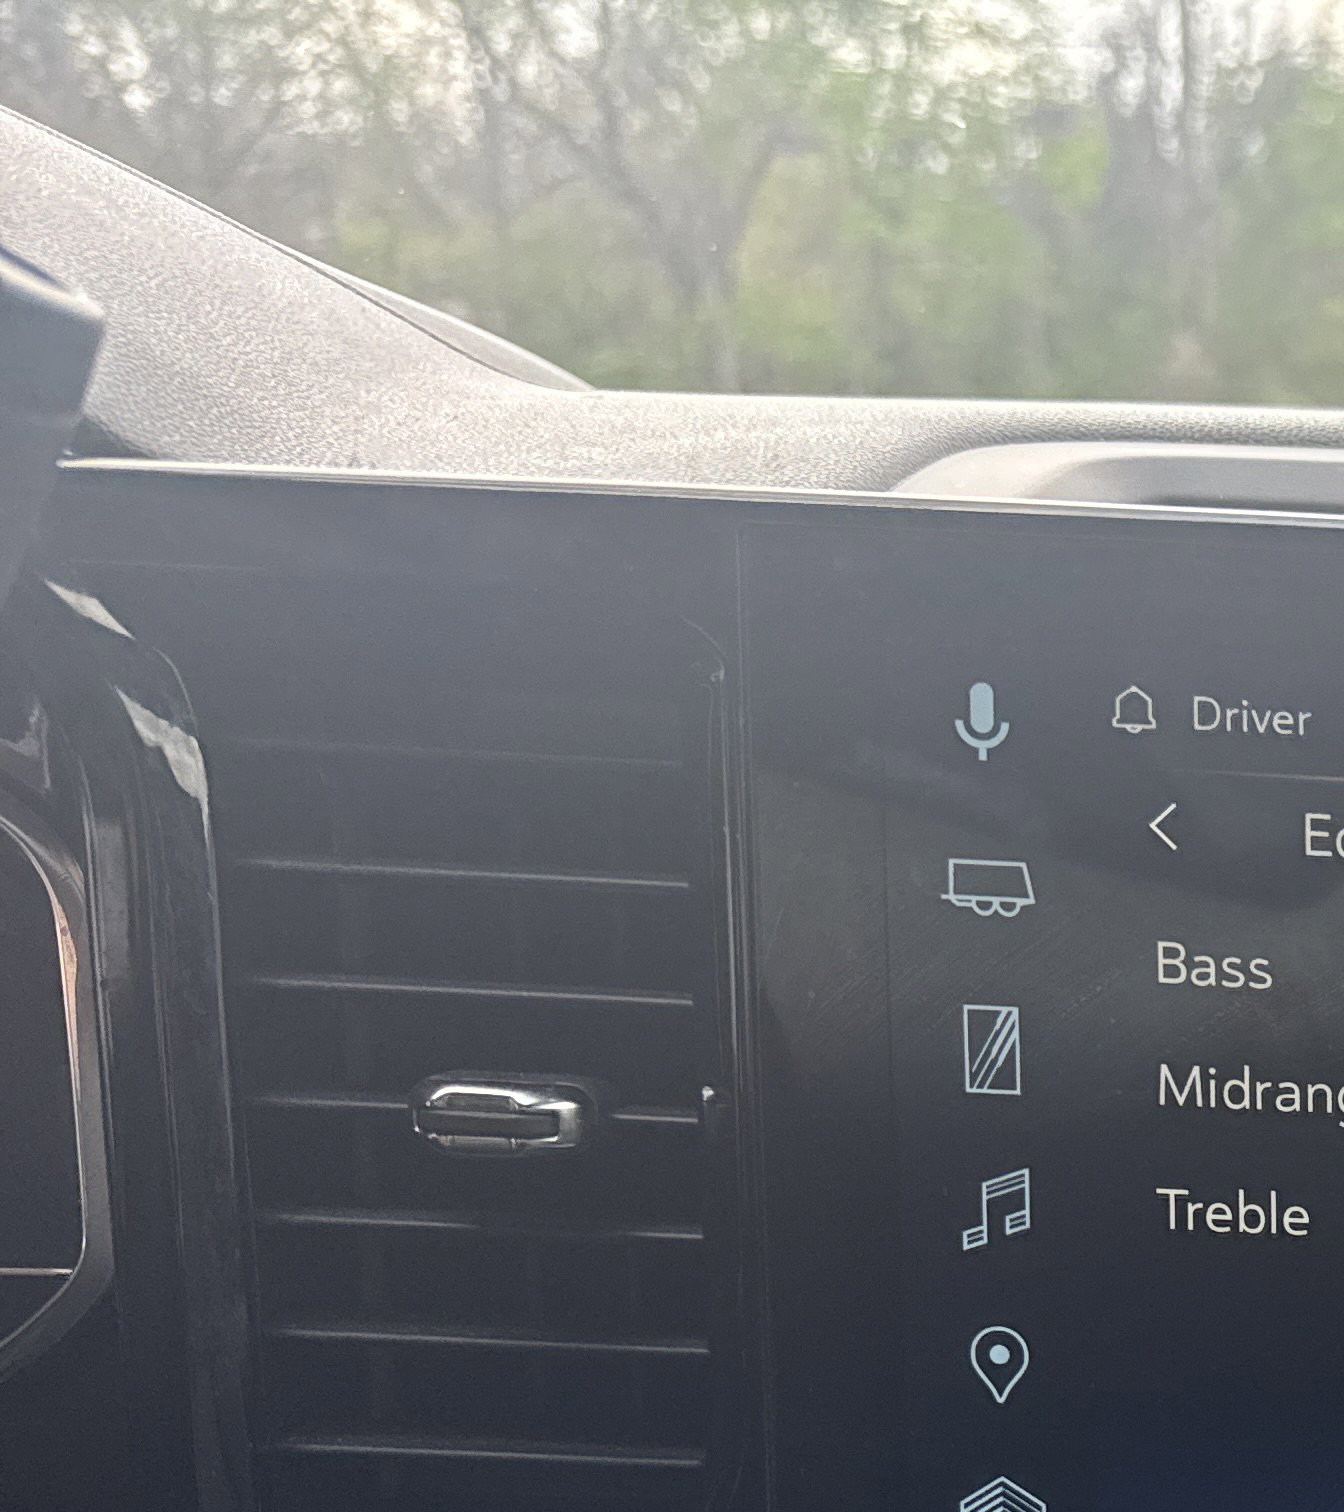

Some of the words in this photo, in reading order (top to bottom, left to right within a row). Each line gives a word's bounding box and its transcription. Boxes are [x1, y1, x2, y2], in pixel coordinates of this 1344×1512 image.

[1193, 695, 1312, 736] Driver
[1157, 940, 1273, 990] Bass
[1155, 1187, 1310, 1236] Treble
